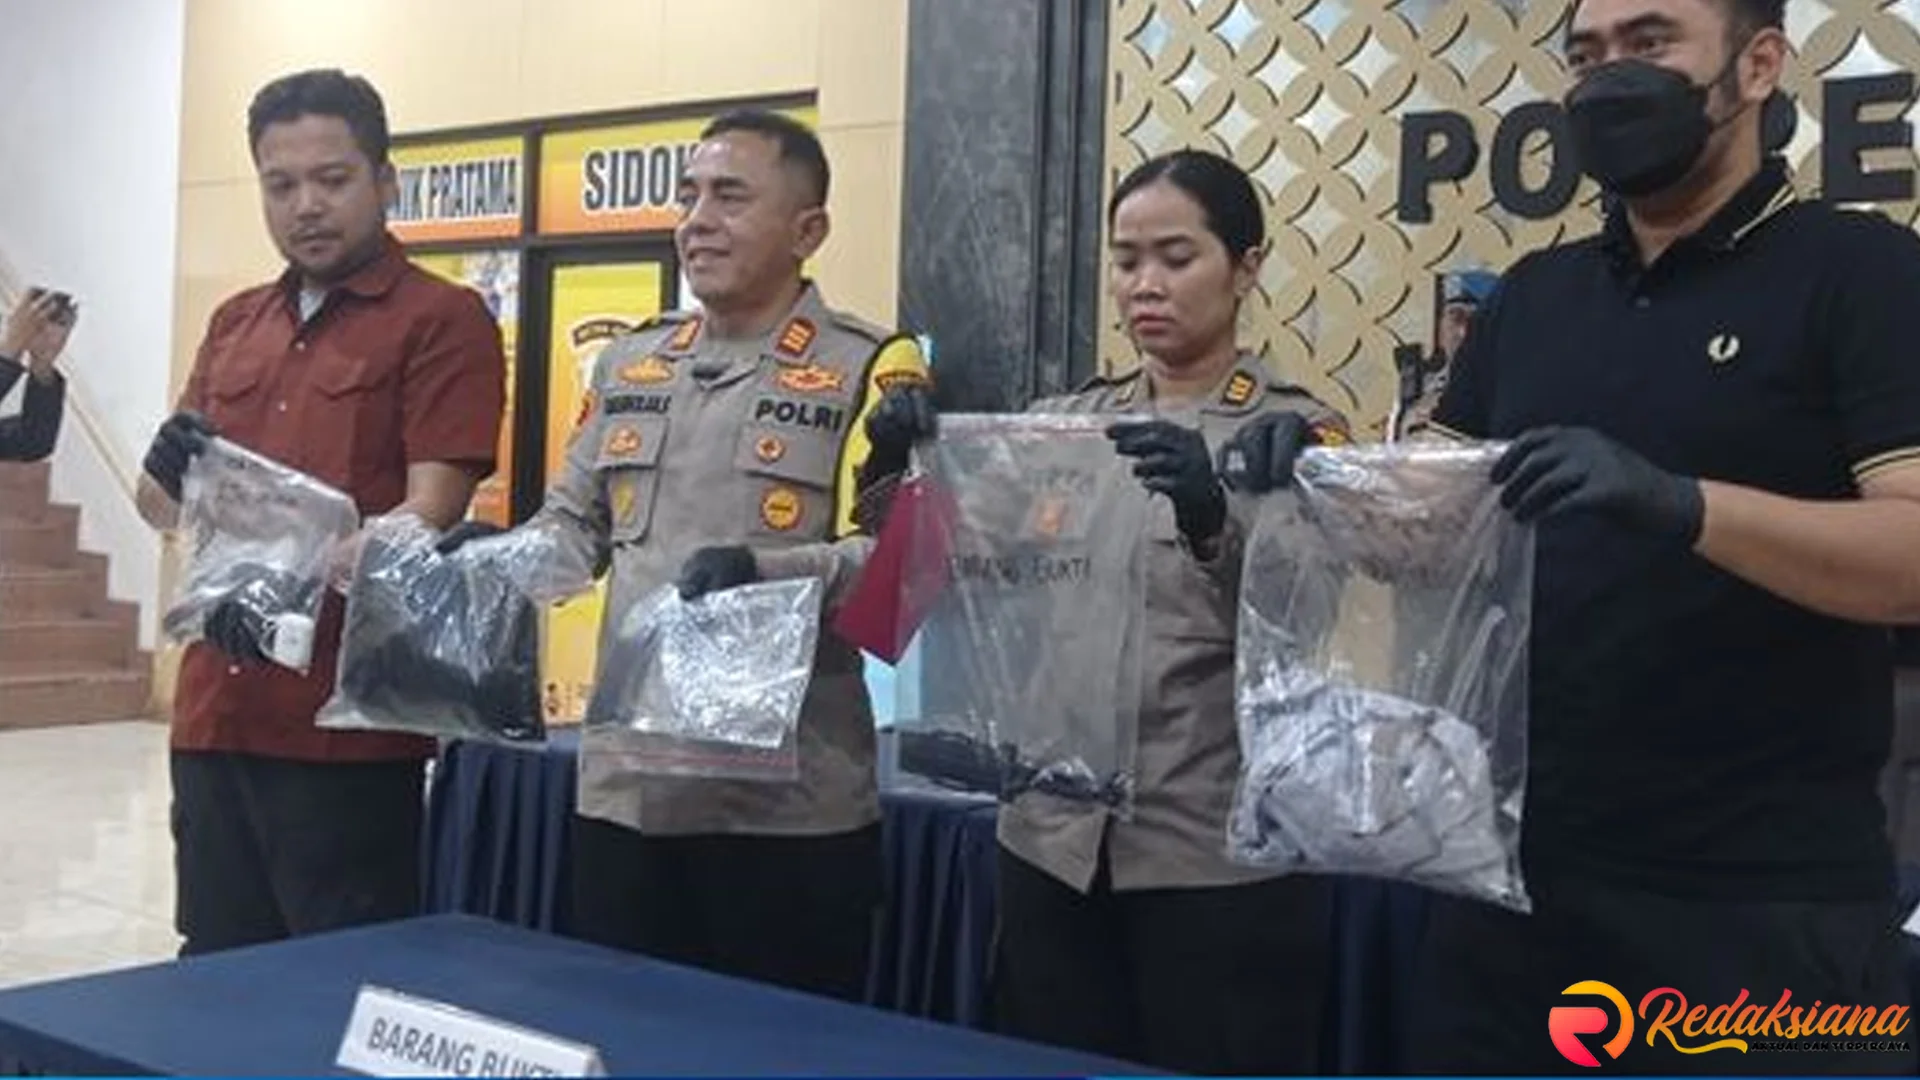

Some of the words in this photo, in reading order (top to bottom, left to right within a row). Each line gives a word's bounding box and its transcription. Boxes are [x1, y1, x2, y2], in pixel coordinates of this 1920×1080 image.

[429, 159, 517, 219] PRATAMA
[755, 399, 843, 430] POLRI
[367, 1017, 475, 1076] BARANG
